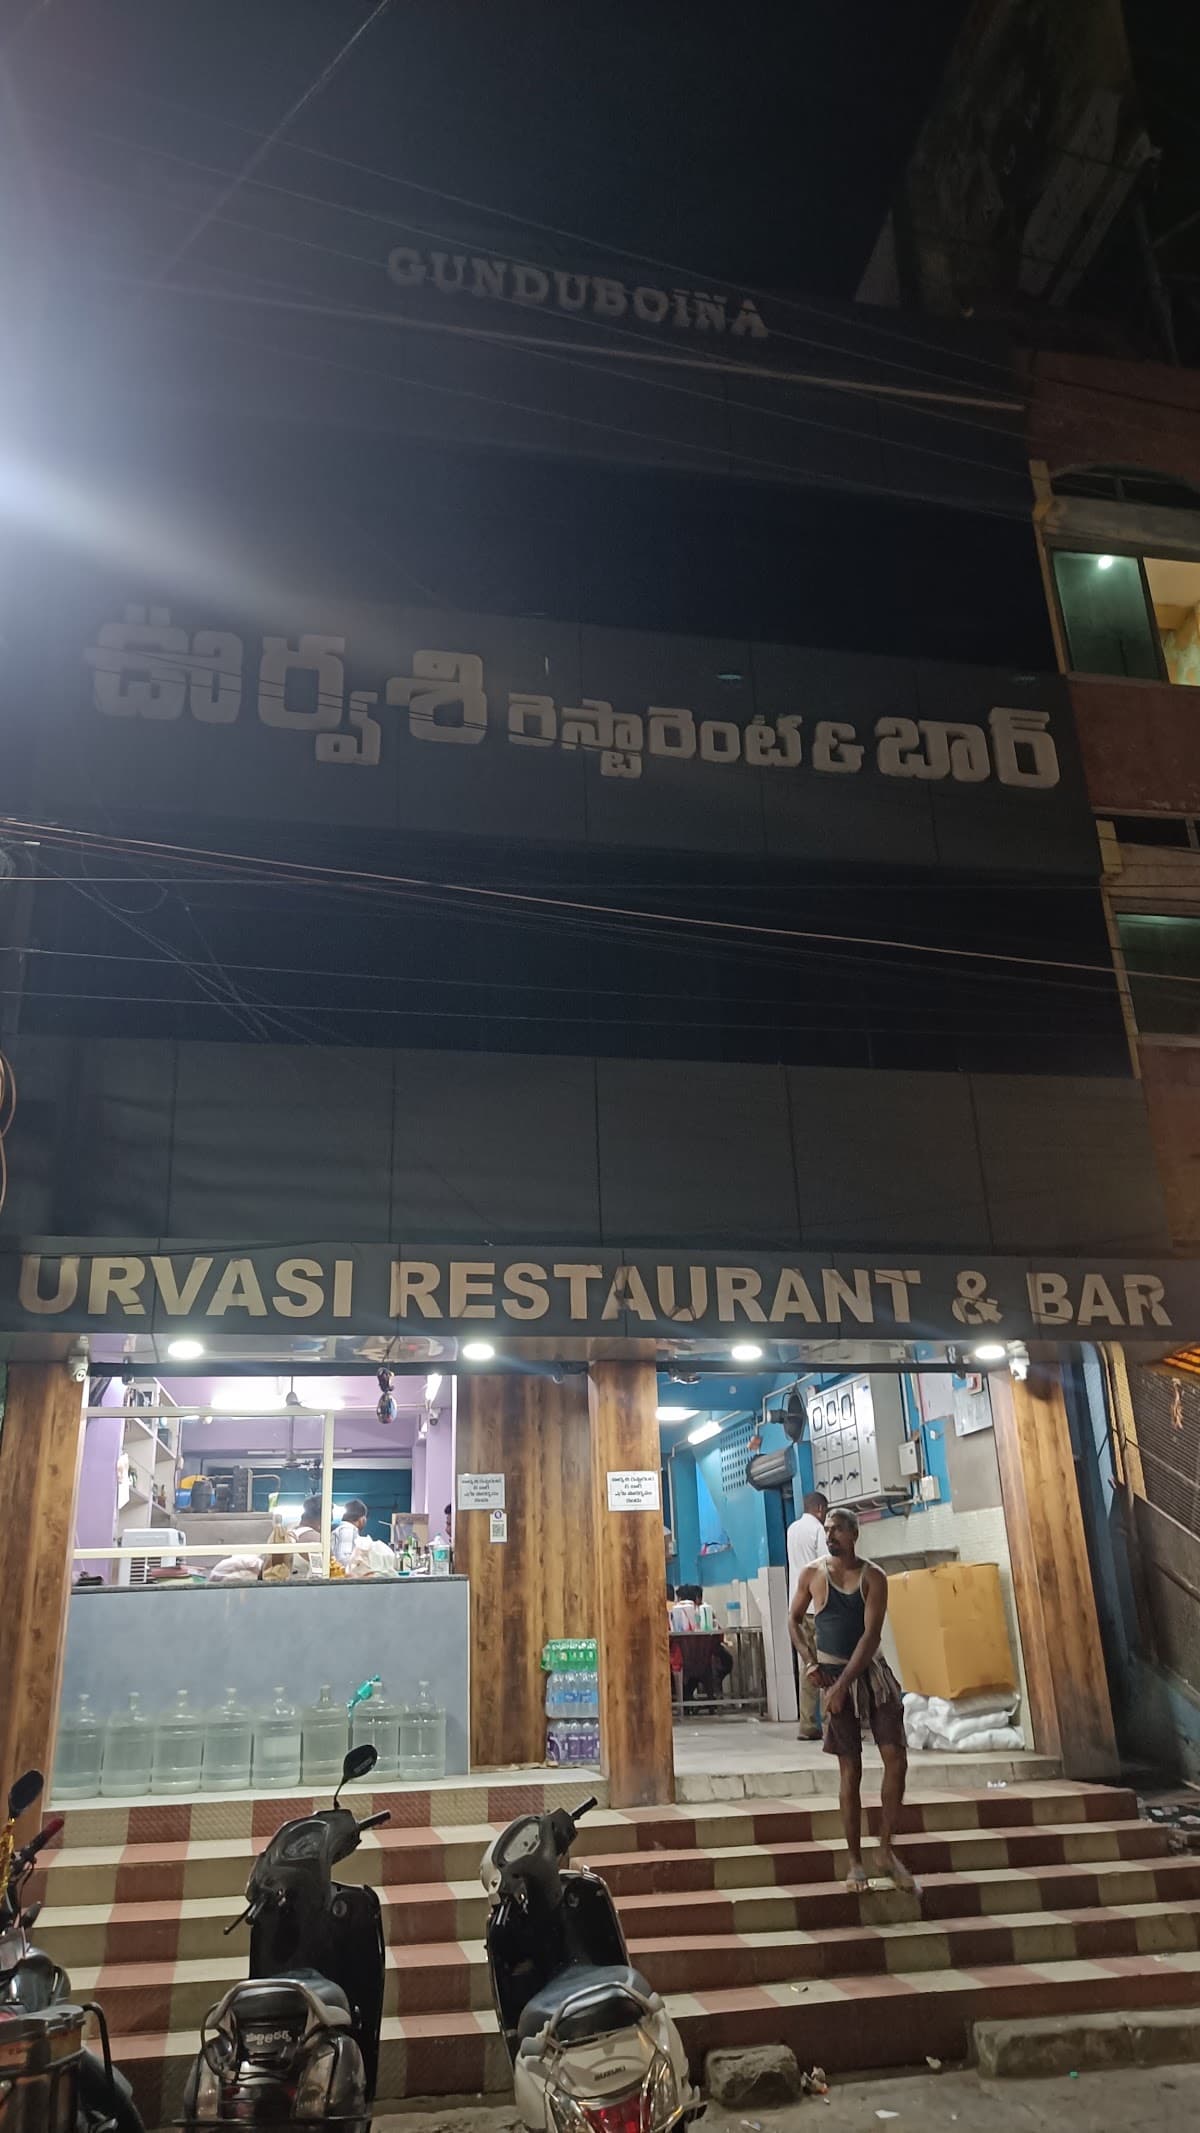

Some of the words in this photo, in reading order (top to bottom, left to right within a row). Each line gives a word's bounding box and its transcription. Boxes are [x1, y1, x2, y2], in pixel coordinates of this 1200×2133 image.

[387, 246, 769, 337] GUNDUBOINA
[812, 721, 865, 773] &
[875, 706, 1061, 789] బార్
[18, 1254, 353, 1318] URVASI
[389, 1260, 921, 1325] RESTAURANT
[951, 1270, 1004, 1325] &
[1025, 1271, 1173, 1326] BAR
